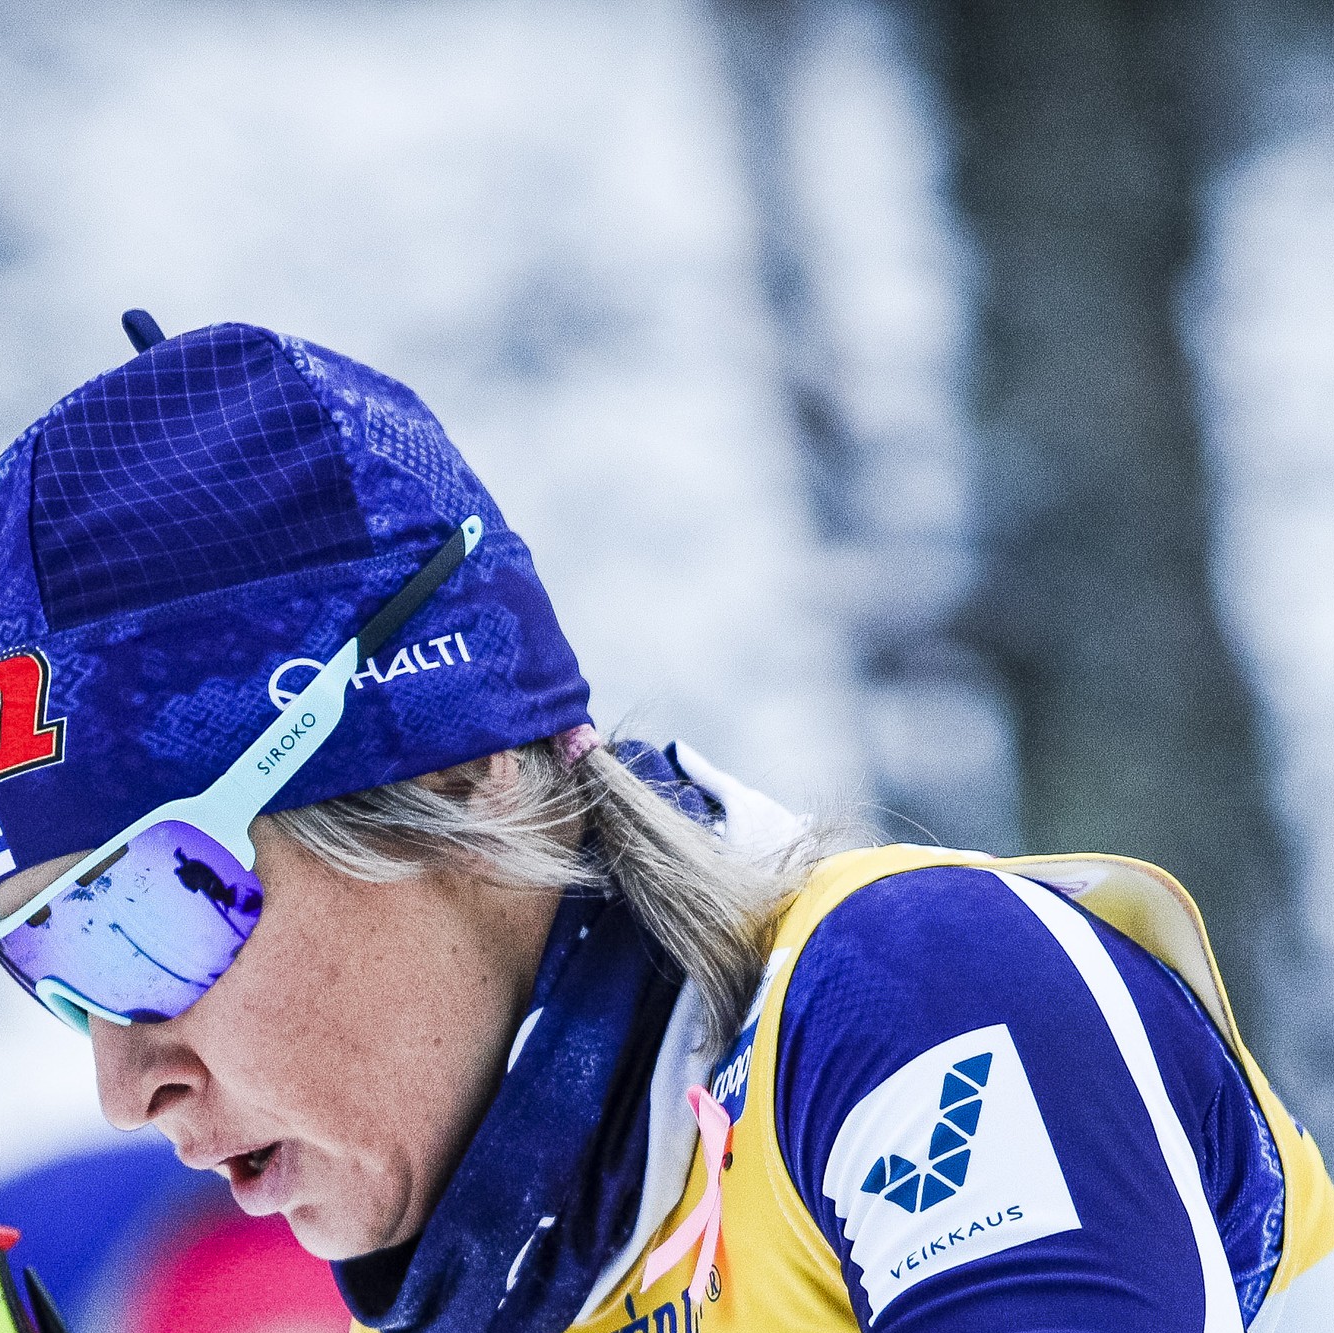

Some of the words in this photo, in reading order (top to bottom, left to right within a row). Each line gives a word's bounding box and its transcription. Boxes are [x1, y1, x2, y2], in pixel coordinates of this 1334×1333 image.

[350, 631, 471, 690] HALTI
[256, 712, 316, 776] SIROKO
[889, 1204, 1024, 1280] VEIKKAUS
